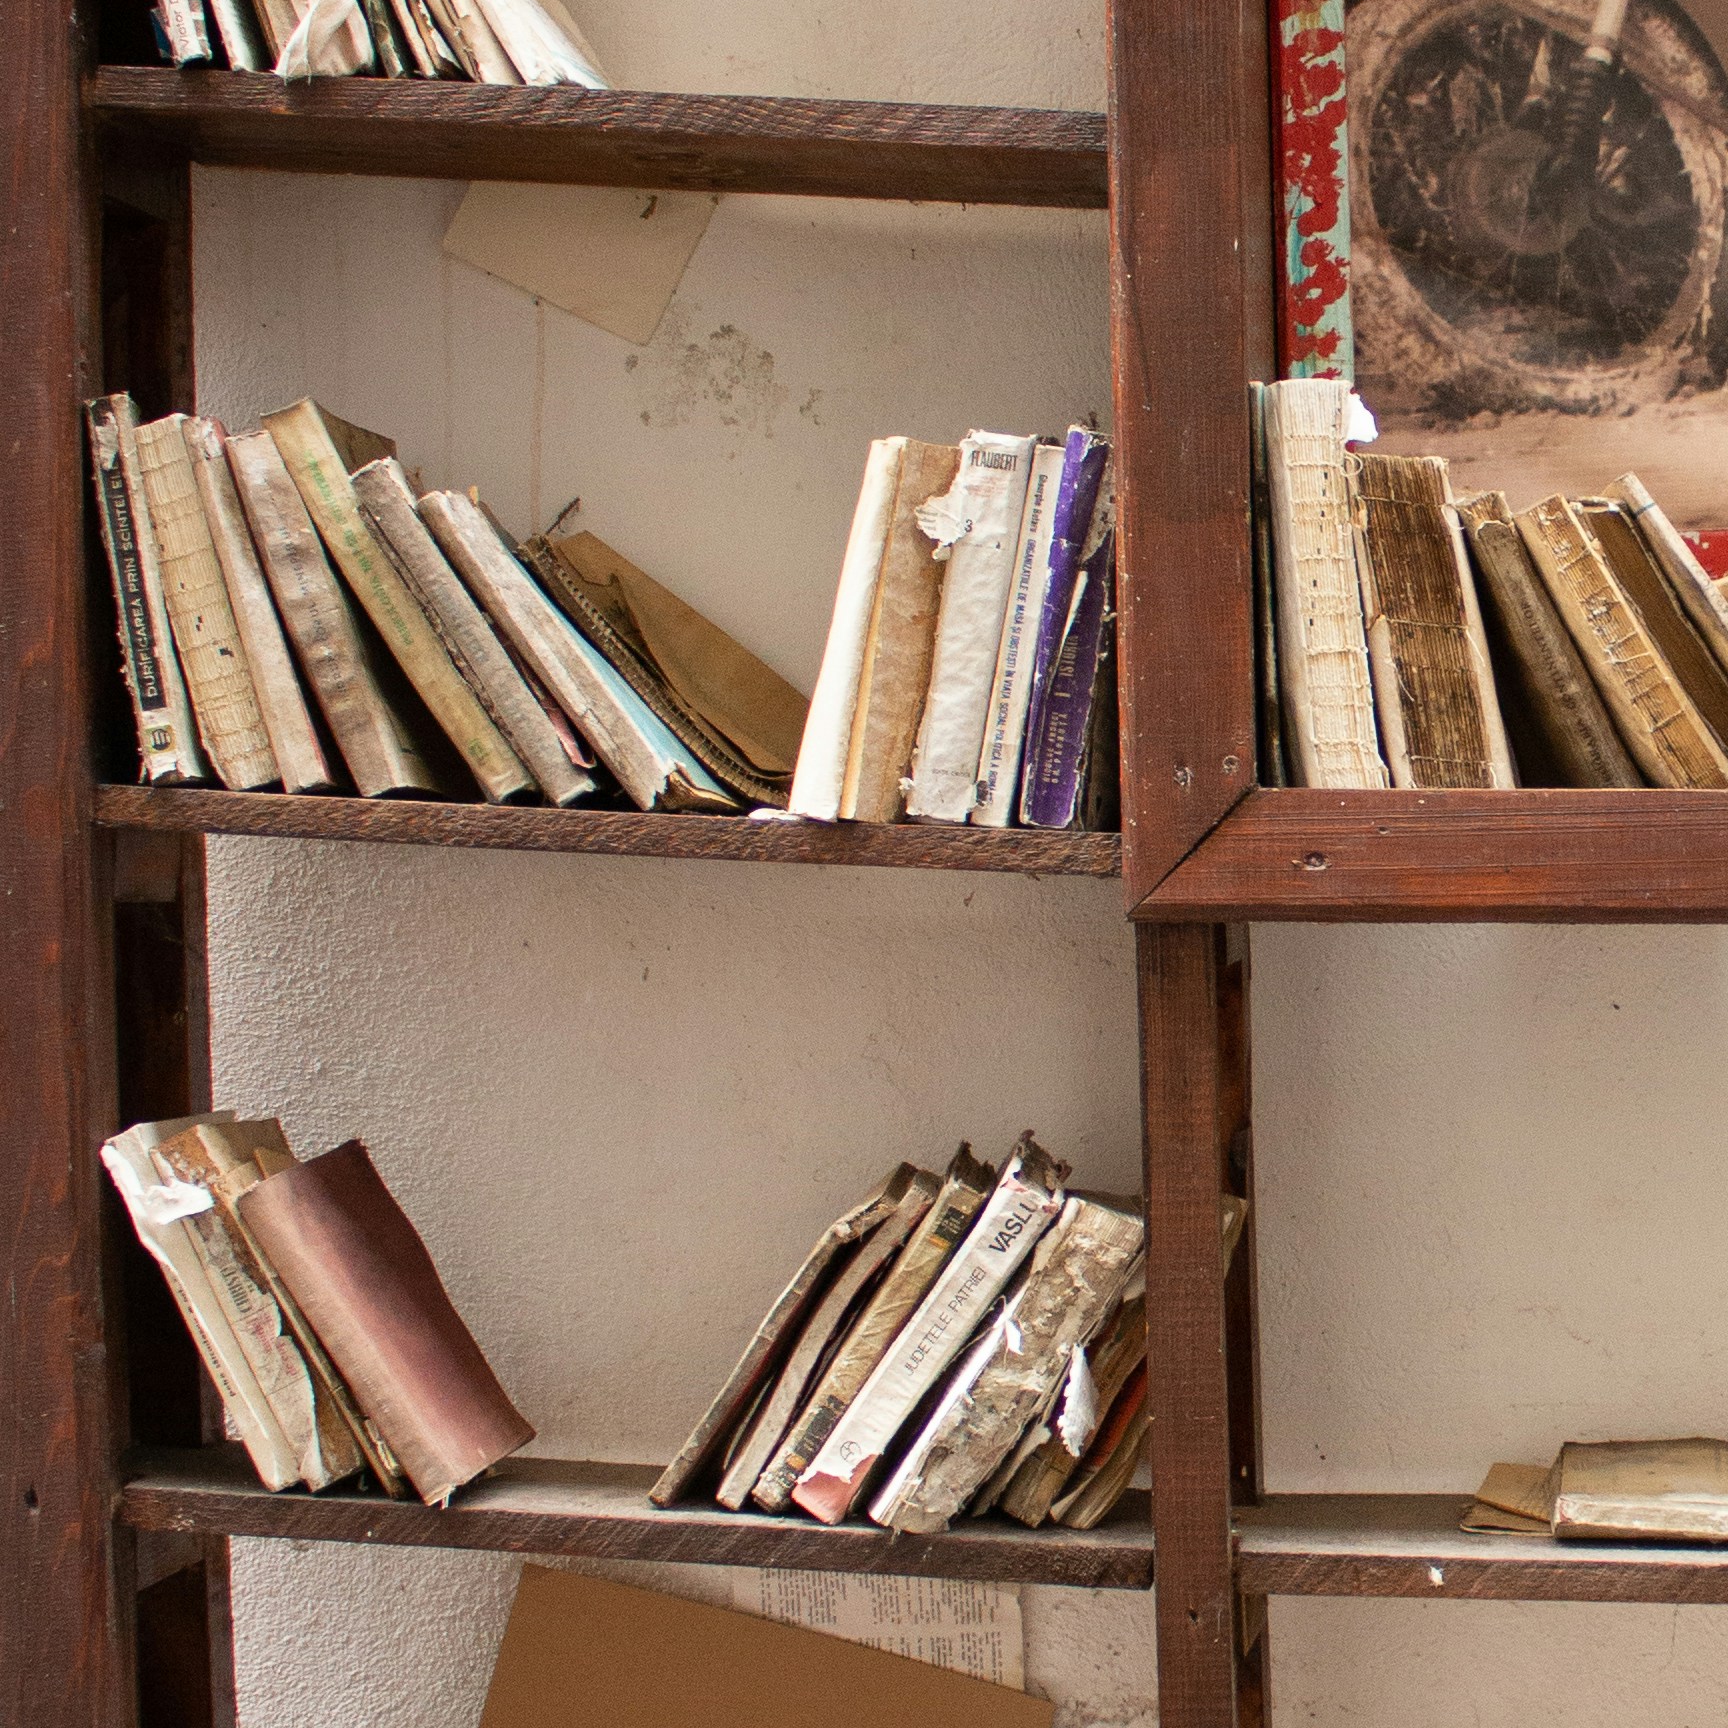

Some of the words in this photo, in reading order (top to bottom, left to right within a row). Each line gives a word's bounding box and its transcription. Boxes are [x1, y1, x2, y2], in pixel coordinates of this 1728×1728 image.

[170, 8, 190, 49] Victor
[970, 450, 1018, 472] FLAUBERT
[964, 519, 973, 533] 3
[123, 555, 140, 592] PRIN
[1016, 592, 1027, 602] DE
[946, 1264, 989, 1314] PATRIEI
